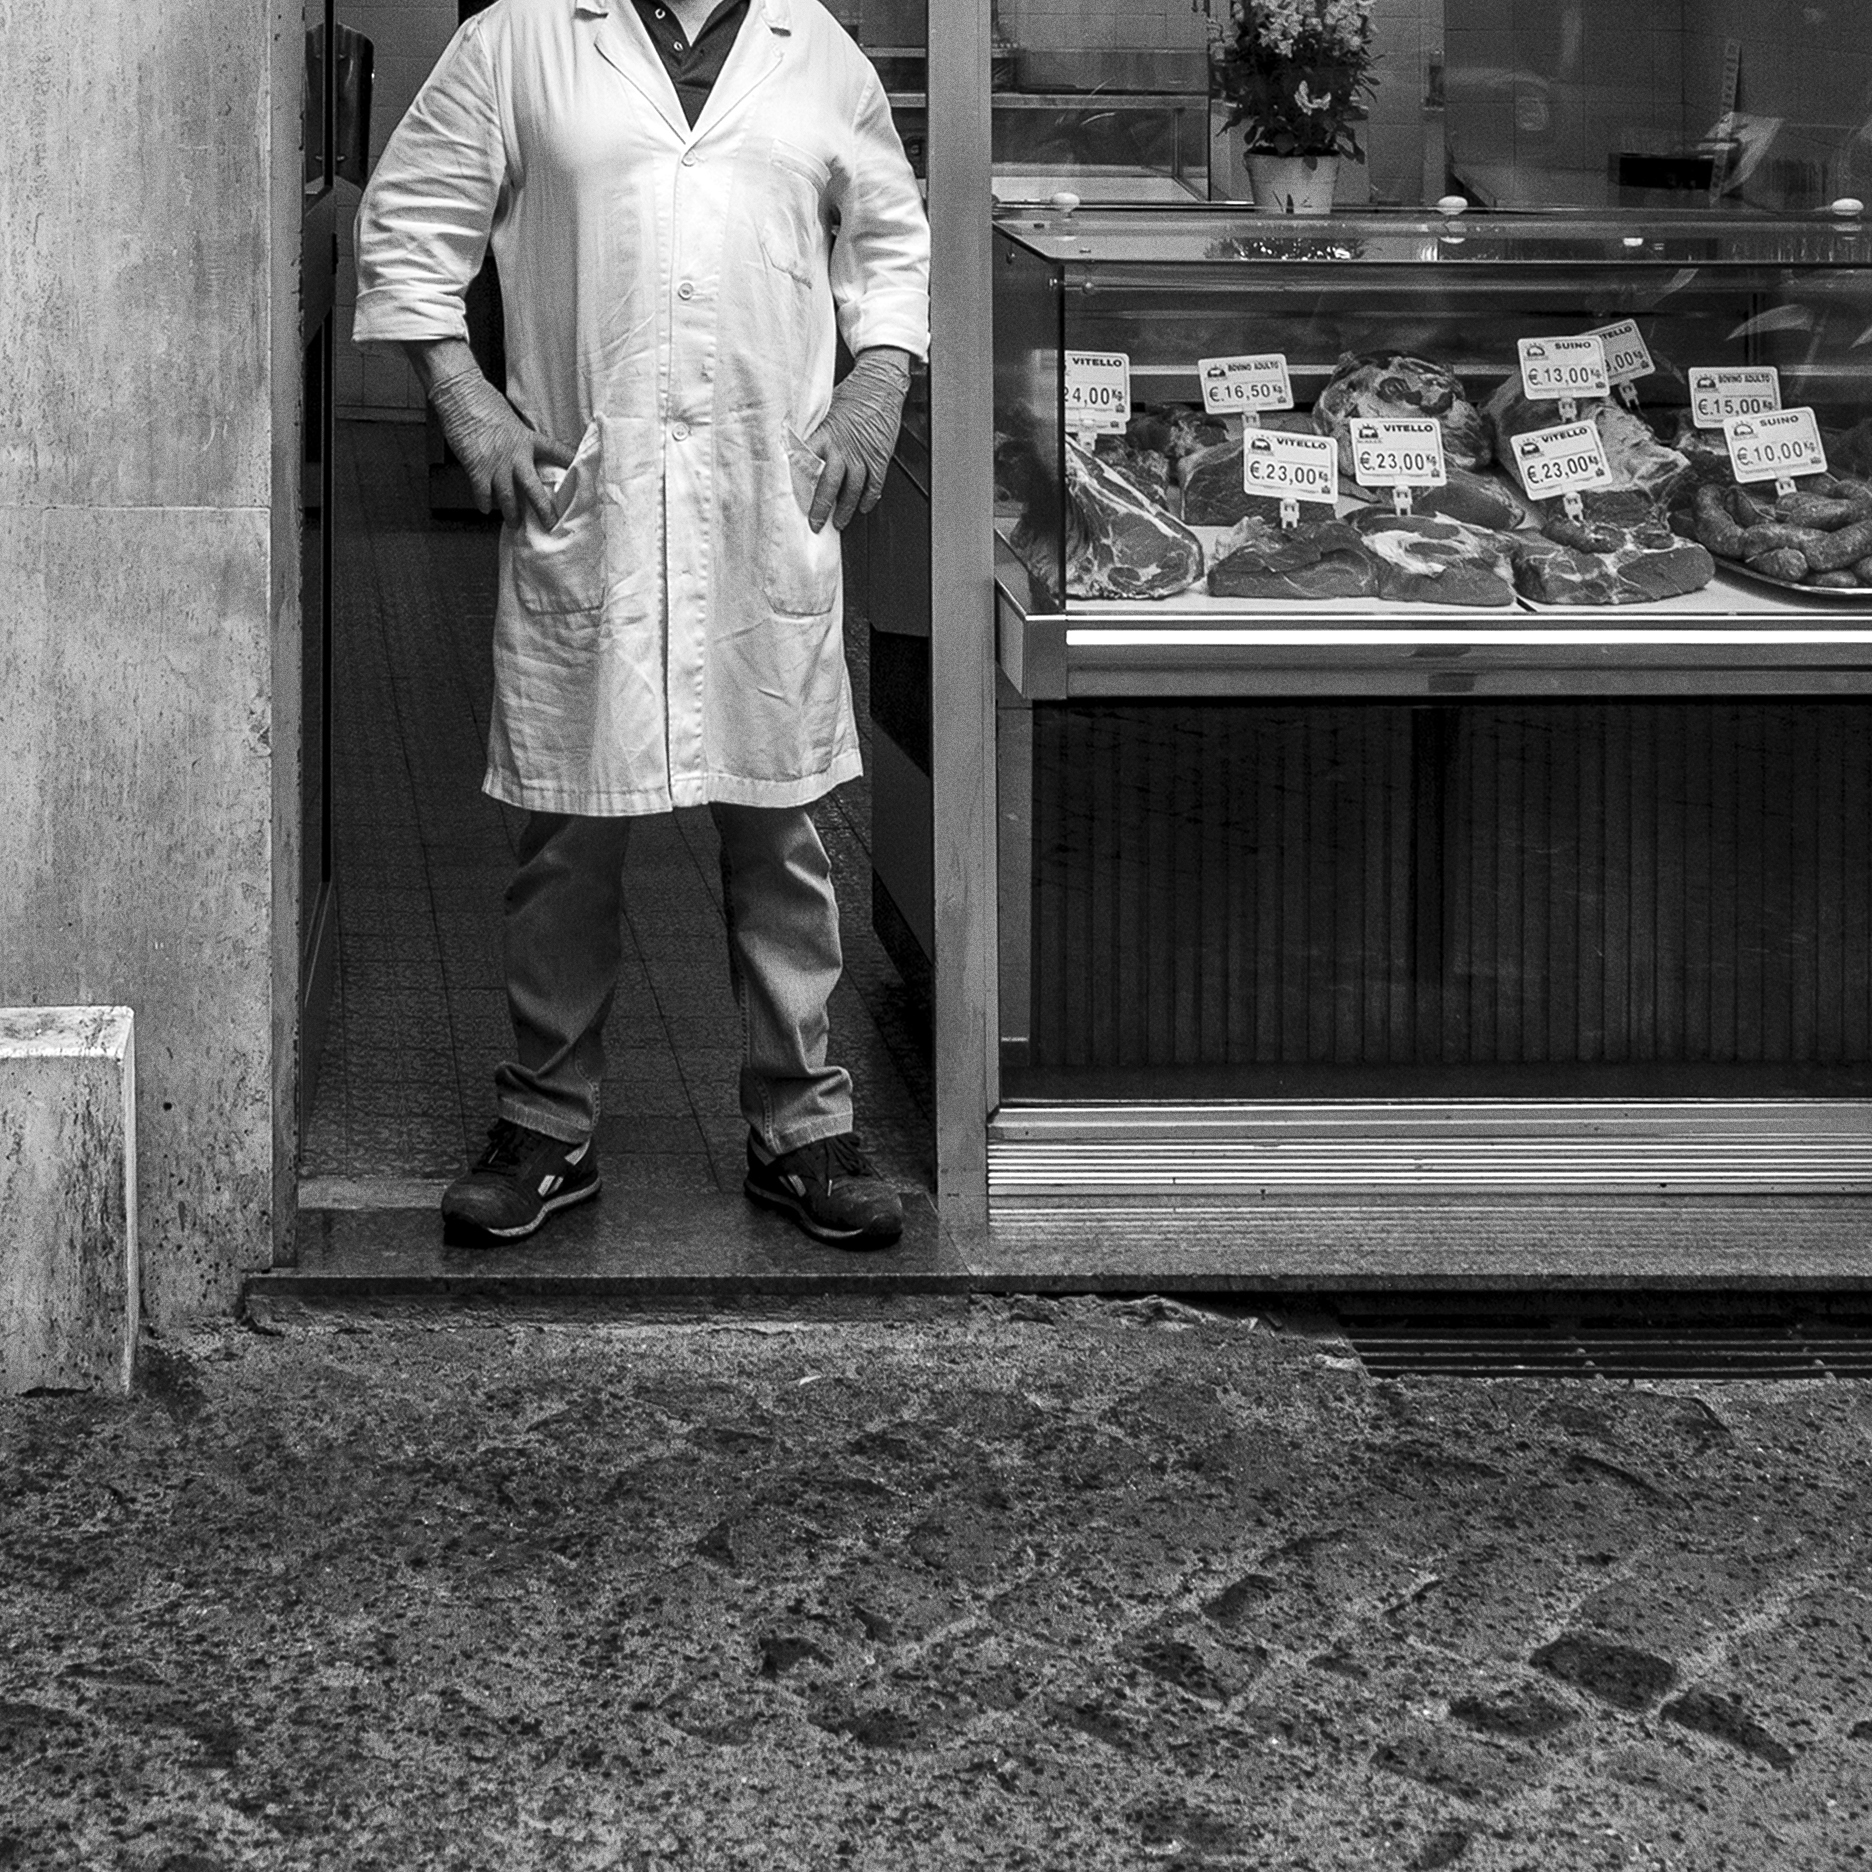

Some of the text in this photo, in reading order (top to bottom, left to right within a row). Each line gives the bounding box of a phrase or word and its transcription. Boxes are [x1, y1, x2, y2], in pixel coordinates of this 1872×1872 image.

[1554, 341, 1592, 350] SUINO
[1072, 357, 1123, 367] VITELLO
[1759, 414, 1799, 427] SUINO
[1383, 424, 1433, 432] VITELLO
[1541, 427, 1587, 443] VITELLO
[1276, 437, 1327, 450] VITELLO
